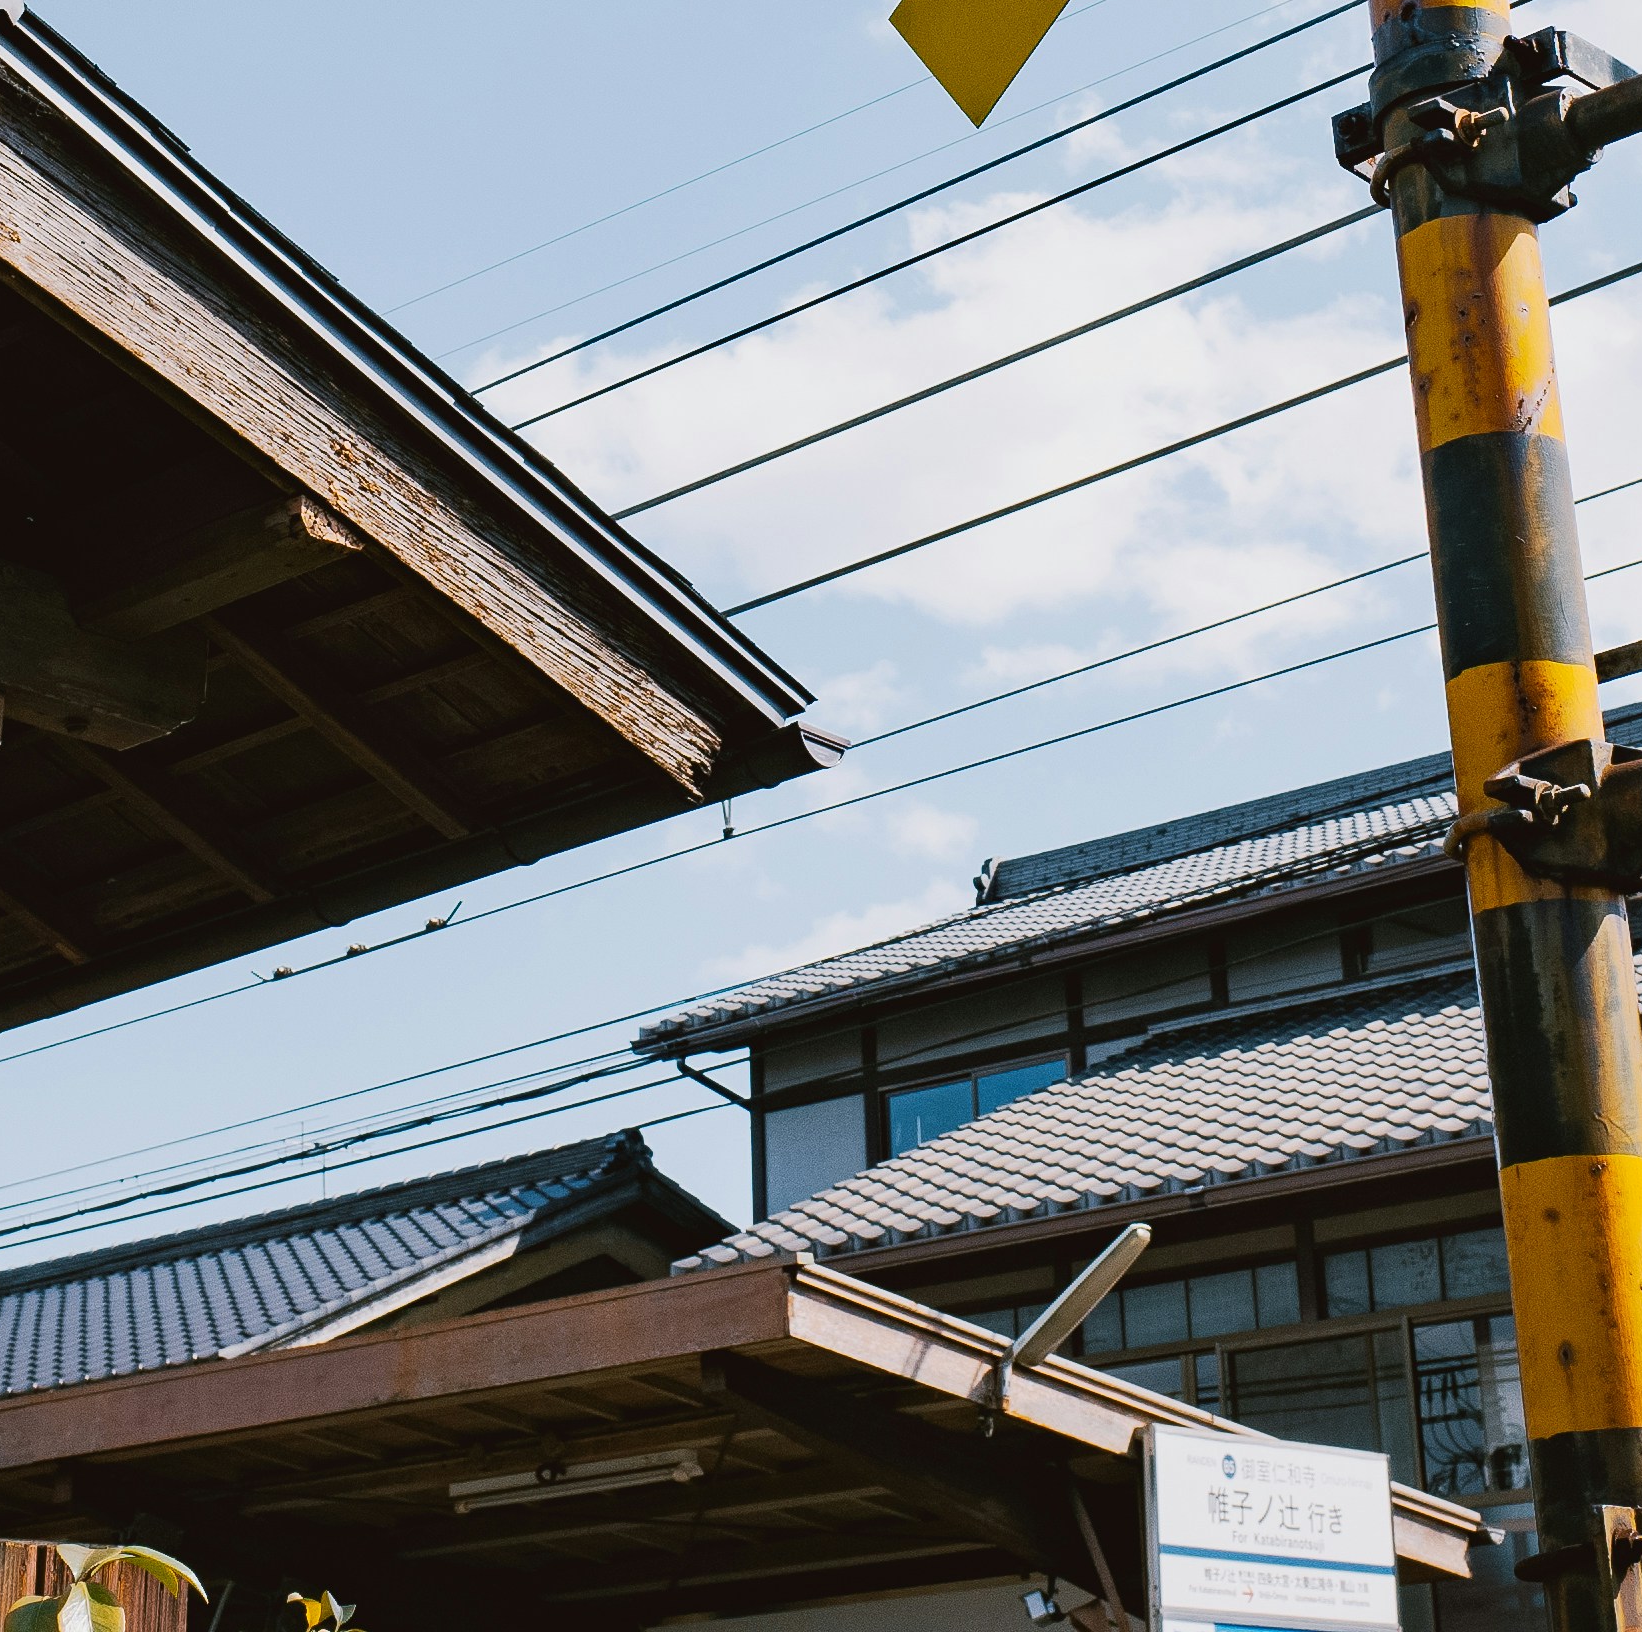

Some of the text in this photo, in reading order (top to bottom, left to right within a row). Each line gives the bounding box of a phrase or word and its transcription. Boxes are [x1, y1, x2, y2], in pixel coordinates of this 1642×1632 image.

[1241, 1457, 1316, 1488] 御室仁和寺
[1232, 1530, 1325, 1553] For Katabiranotsuji
